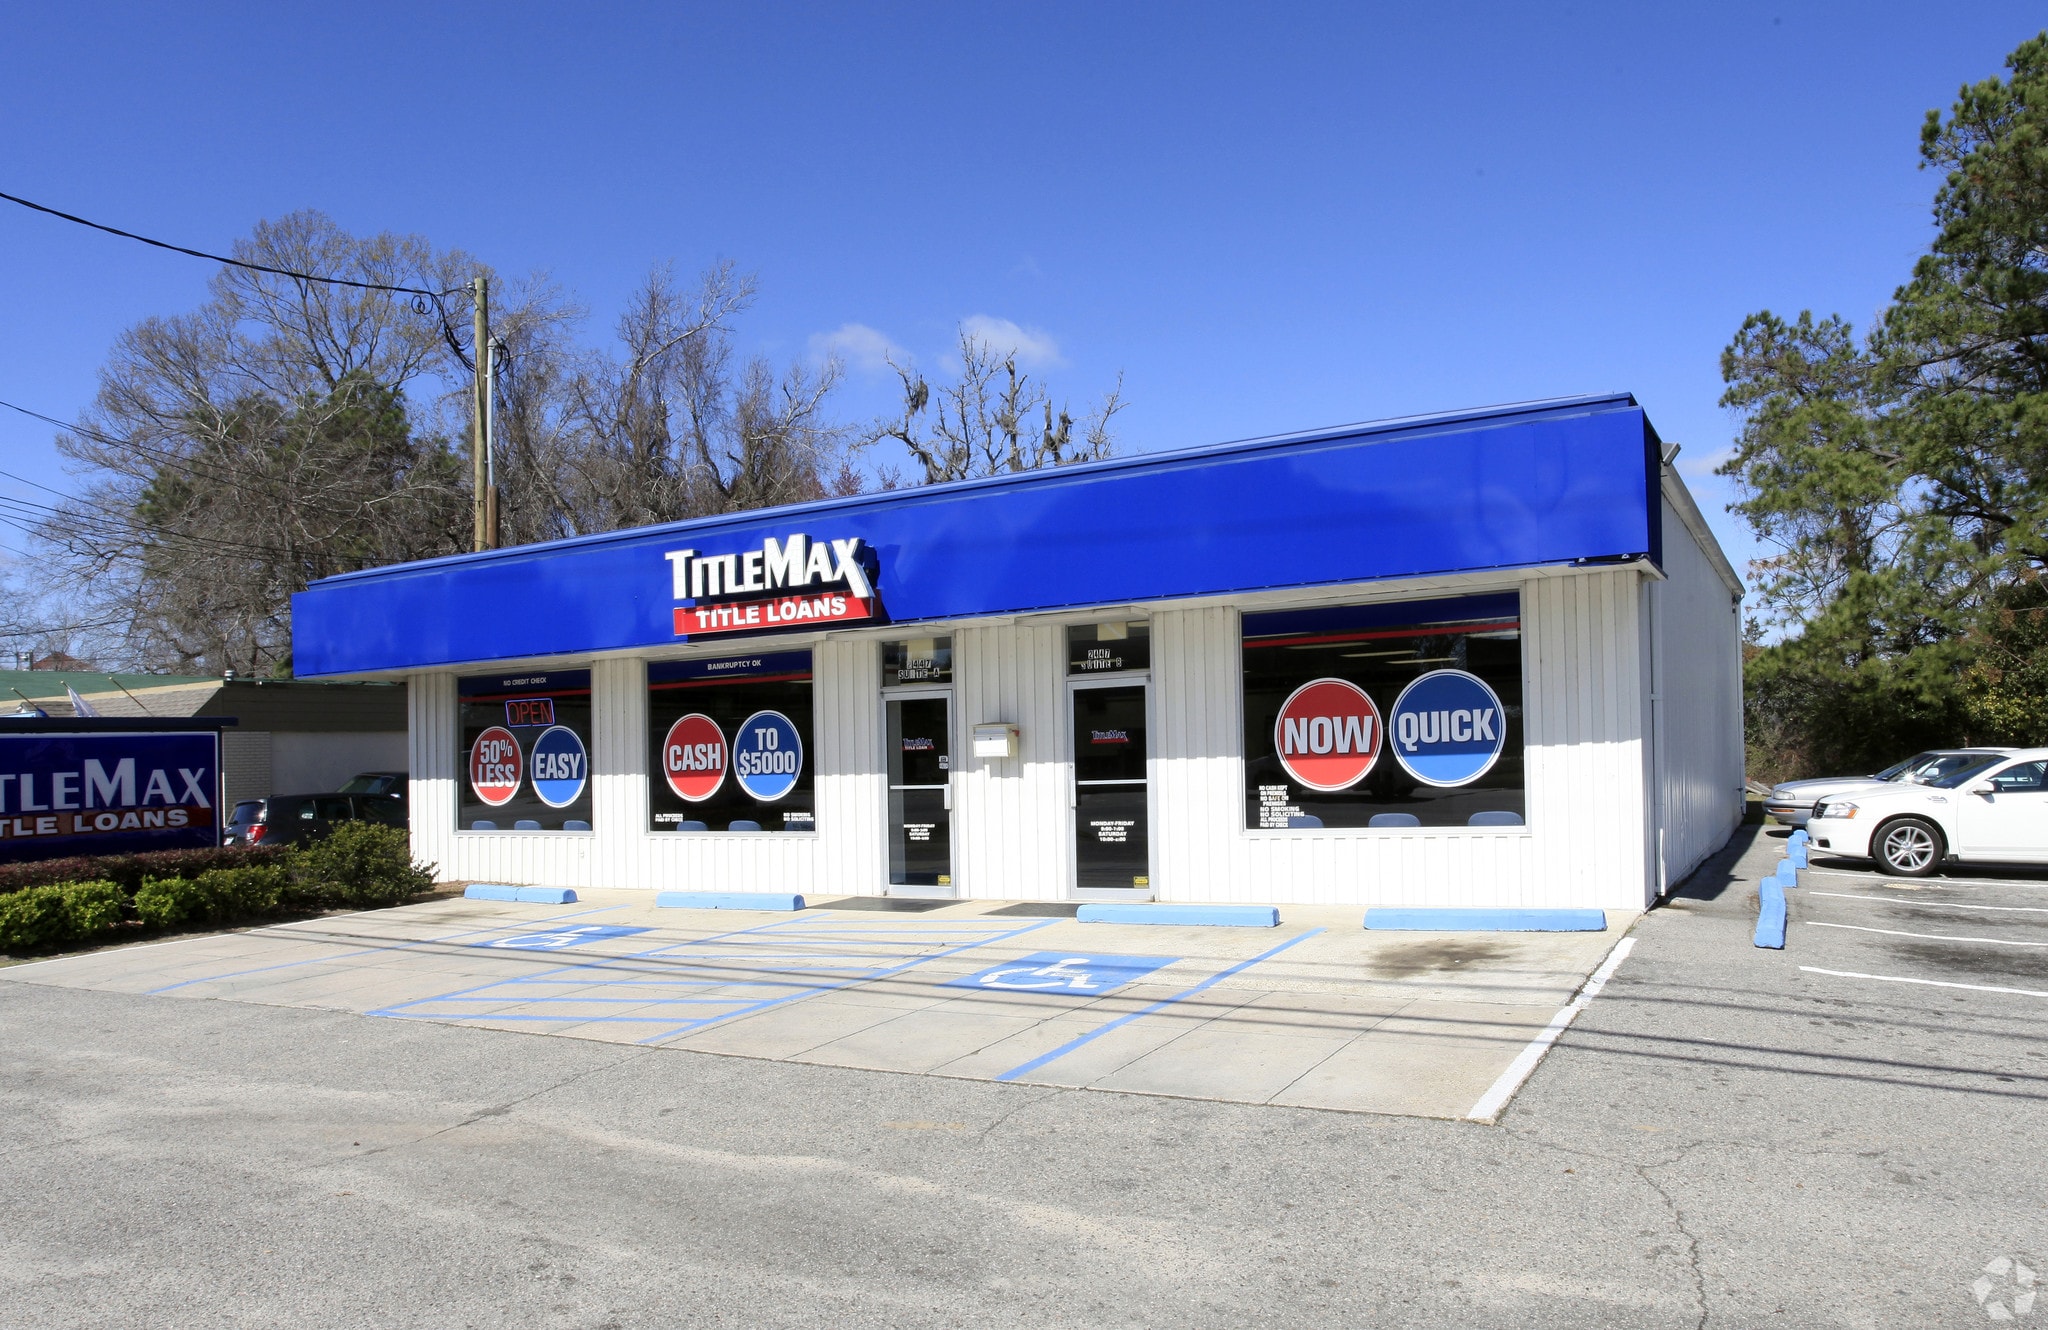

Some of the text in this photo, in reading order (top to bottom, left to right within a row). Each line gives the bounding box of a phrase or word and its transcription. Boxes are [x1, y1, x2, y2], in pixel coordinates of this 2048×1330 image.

[695, 595, 847, 629] TITLE LOANS
[707, 659, 762, 671] BANKRUPTCY OK
[906, 659, 932, 670] 2447
[1088, 648, 1111, 660] 2447
[512, 678, 530, 686] CREDIT
[530, 676, 547, 685] CHECK
[897, 667, 940, 680] SUITE A
[508, 701, 553, 725] OPEN
[754, 727, 778, 751] TO
[1284, 715, 1373, 755] NOW
[1398, 708, 1496, 752] QUICK
[480, 739, 513, 764] 50%
[669, 742, 722, 772] CASH
[739, 749, 796, 779] $5000
[477, 763, 515, 788] LESS
[535, 752, 582, 780] EASY
[74, 808, 189, 833] LOANS
